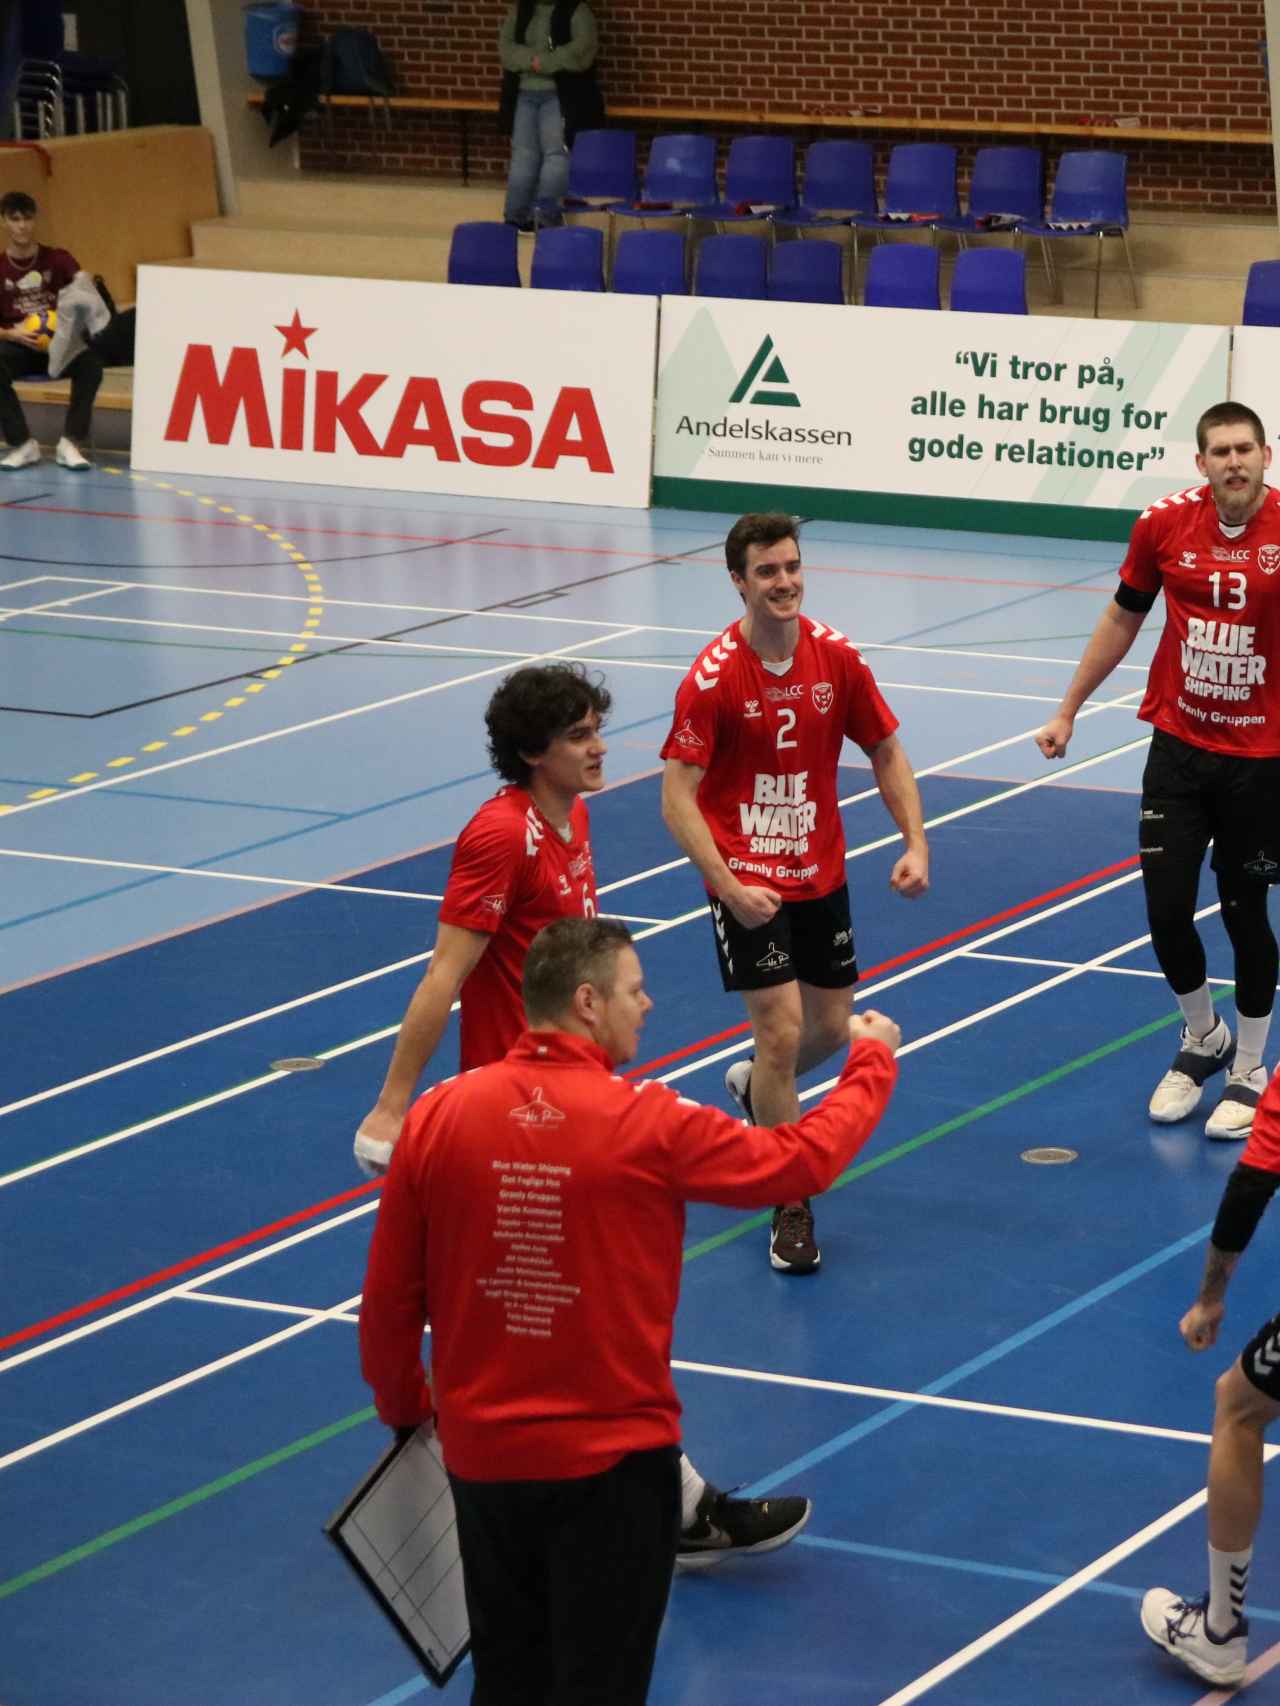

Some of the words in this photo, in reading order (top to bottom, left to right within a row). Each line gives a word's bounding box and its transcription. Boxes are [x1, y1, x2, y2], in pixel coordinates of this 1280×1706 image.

[1009, 354, 1067, 381] tror
[1077, 356, 1124, 392] på,
[674, 415, 853, 446] Andelskassen
[910, 390, 967, 417] alle
[977, 393, 1029, 421] har
[1039, 397, 1111, 433] brug
[1121, 402, 1167, 430] for
[708, 447, 756, 460] Sammen
[759, 449, 779, 462] kan
[795, 455, 824, 465] mere
[907, 433, 984, 462] gode
[1208, 571, 1248, 610] 13
[1186, 616, 1256, 656] BLUE
[1180, 640, 1267, 685] WATER
[1184, 676, 1252, 701] SHIPPING
[776, 708, 798, 749] 2
[1210, 711, 1266, 728] Gruppen
[739, 801, 817, 840] WATER
[728, 856, 772, 877] Granly
